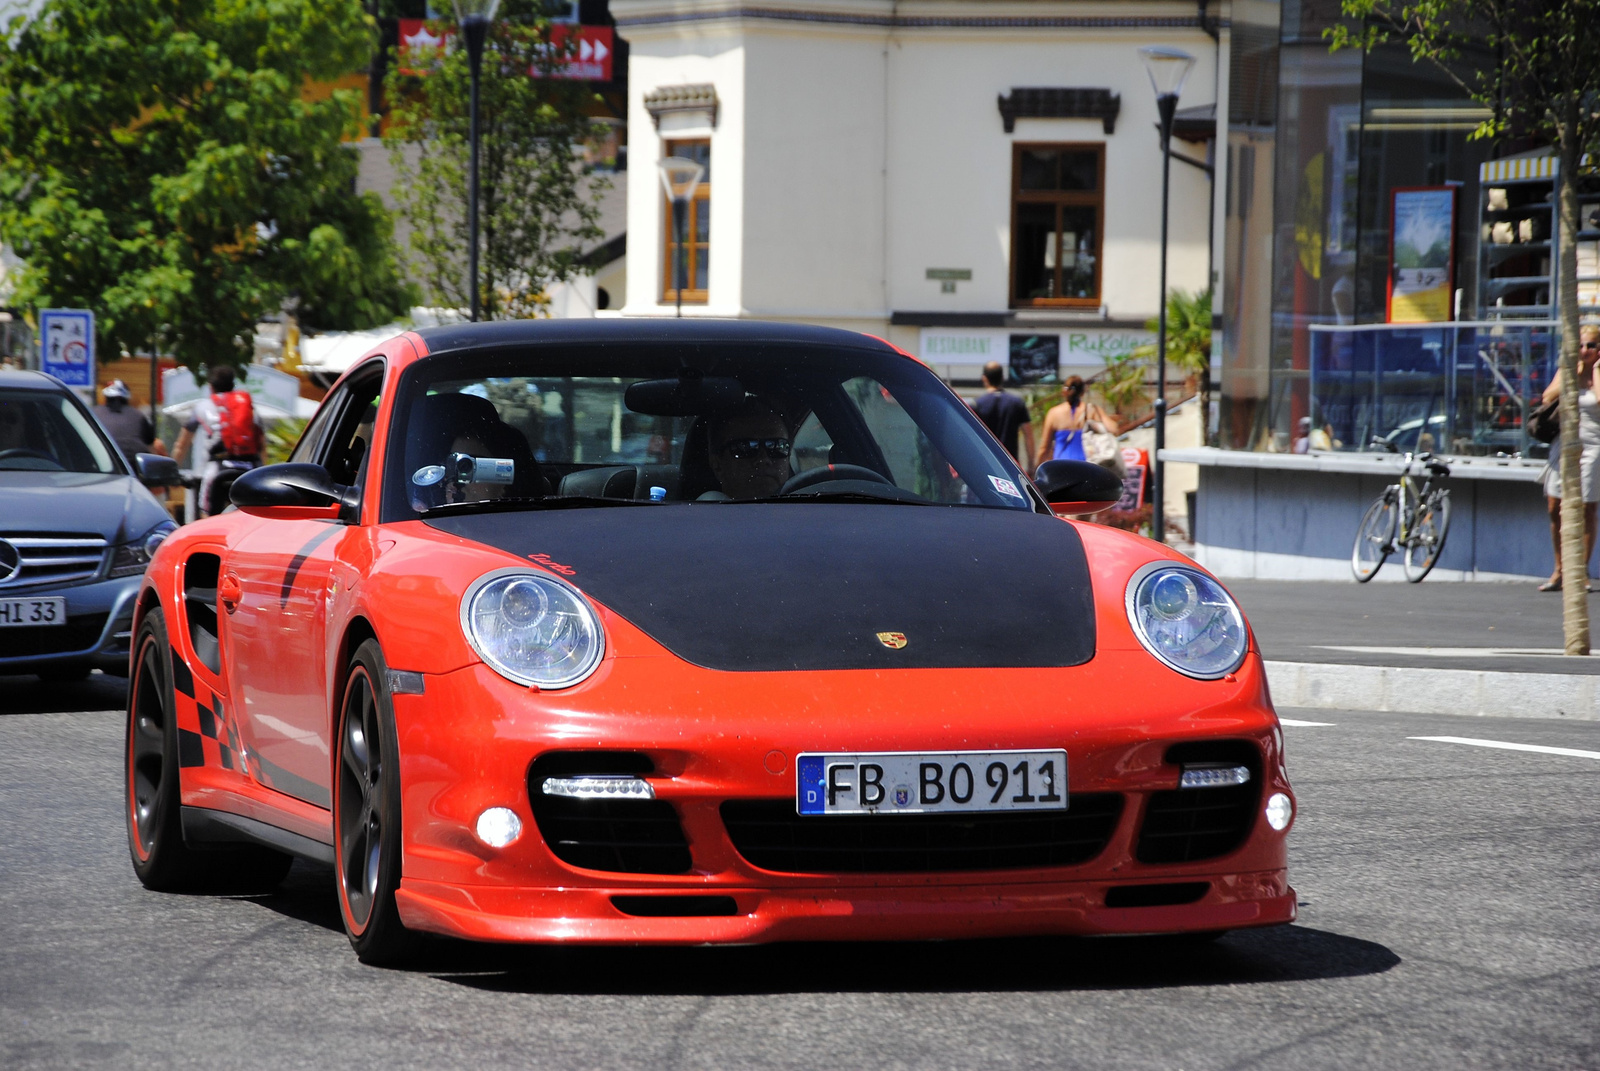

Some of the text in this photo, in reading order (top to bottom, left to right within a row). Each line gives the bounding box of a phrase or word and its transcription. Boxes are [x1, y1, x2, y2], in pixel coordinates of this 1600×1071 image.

[926, 336, 991, 355] RESTAURANT
[528, 553, 576, 575] turbo
[30, 601, 56, 622] 33
[827, 760, 1061, 806] FB BO 911
[807, 790, 817, 803] D
